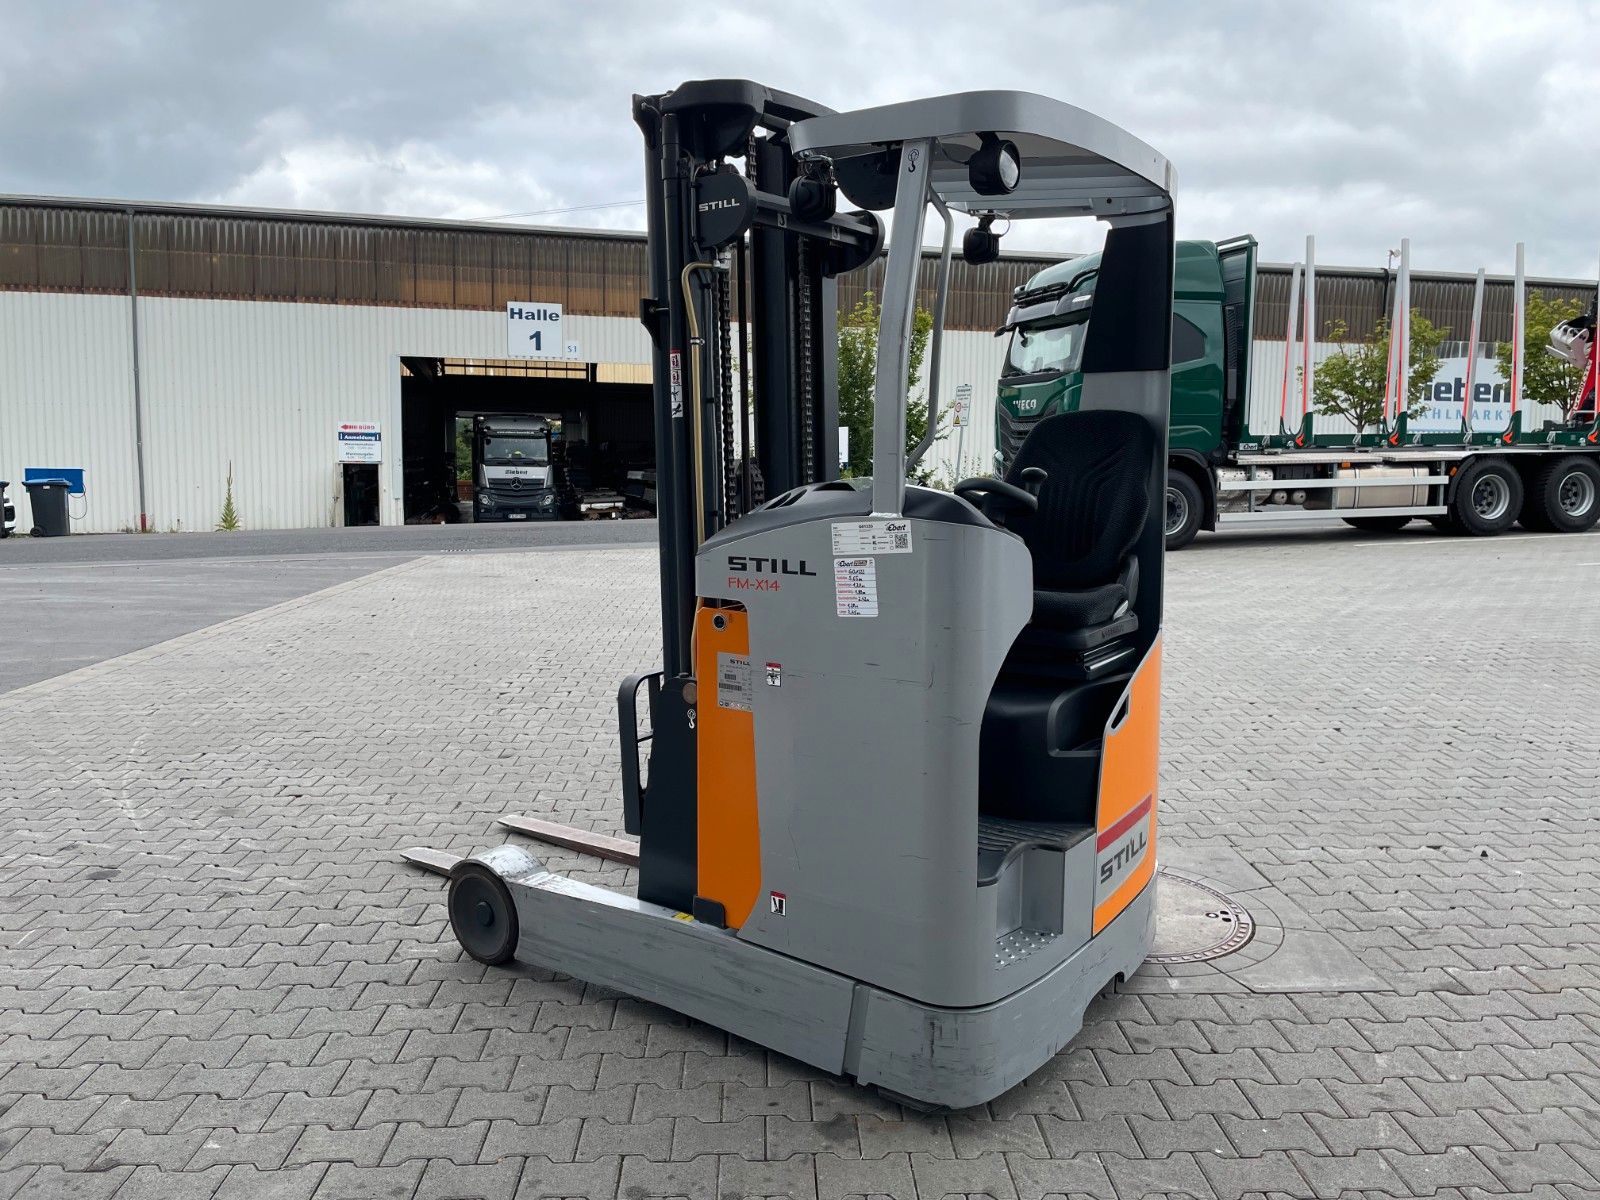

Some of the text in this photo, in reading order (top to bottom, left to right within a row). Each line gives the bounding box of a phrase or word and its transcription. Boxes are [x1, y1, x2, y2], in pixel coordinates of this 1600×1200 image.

[698, 198, 740, 212] STILL
[509, 307, 560, 322] Halle
[529, 330, 542, 351] 1
[1013, 399, 1037, 410] IVECO
[728, 556, 817, 577] STILL
[728, 577, 781, 593] FM-X14
[1100, 831, 1148, 885] STILL
